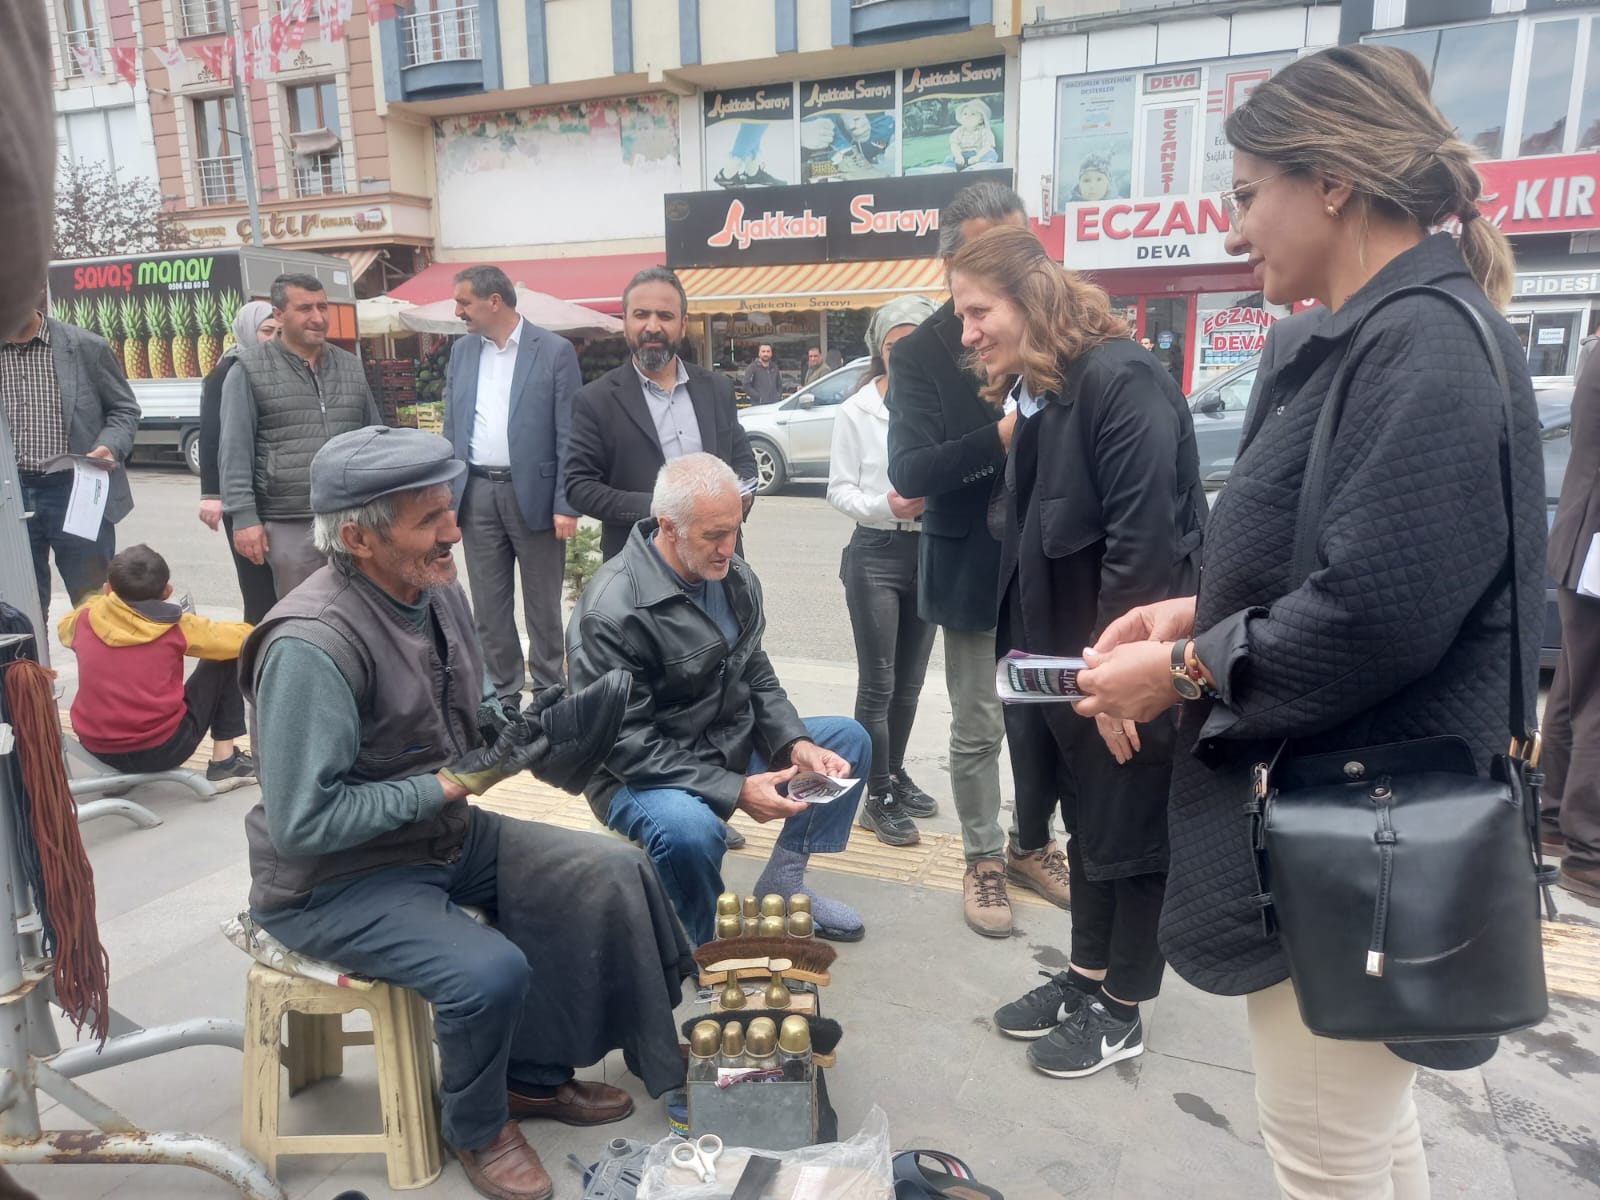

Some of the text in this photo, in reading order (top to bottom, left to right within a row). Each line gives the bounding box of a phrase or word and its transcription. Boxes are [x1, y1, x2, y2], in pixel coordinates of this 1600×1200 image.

[903, 62, 1002, 93] Ayakkabı Sarayı
[1150, 73, 1196, 90] DEVA
[708, 90, 790, 118] Ayakkabı Sarayı
[804, 79, 892, 107] Ayakkabı Sarayı
[1512, 175, 1597, 221] KIR
[707, 198, 827, 250] Ayakkabı
[850, 194, 940, 237] Sarayı
[1076, 198, 1231, 241] ECZAN
[1137, 244, 1191, 260] DEVA
[1521, 273, 1598, 294] PİDESİ
[736, 298, 851, 311] Ayakkabı Sarayı
